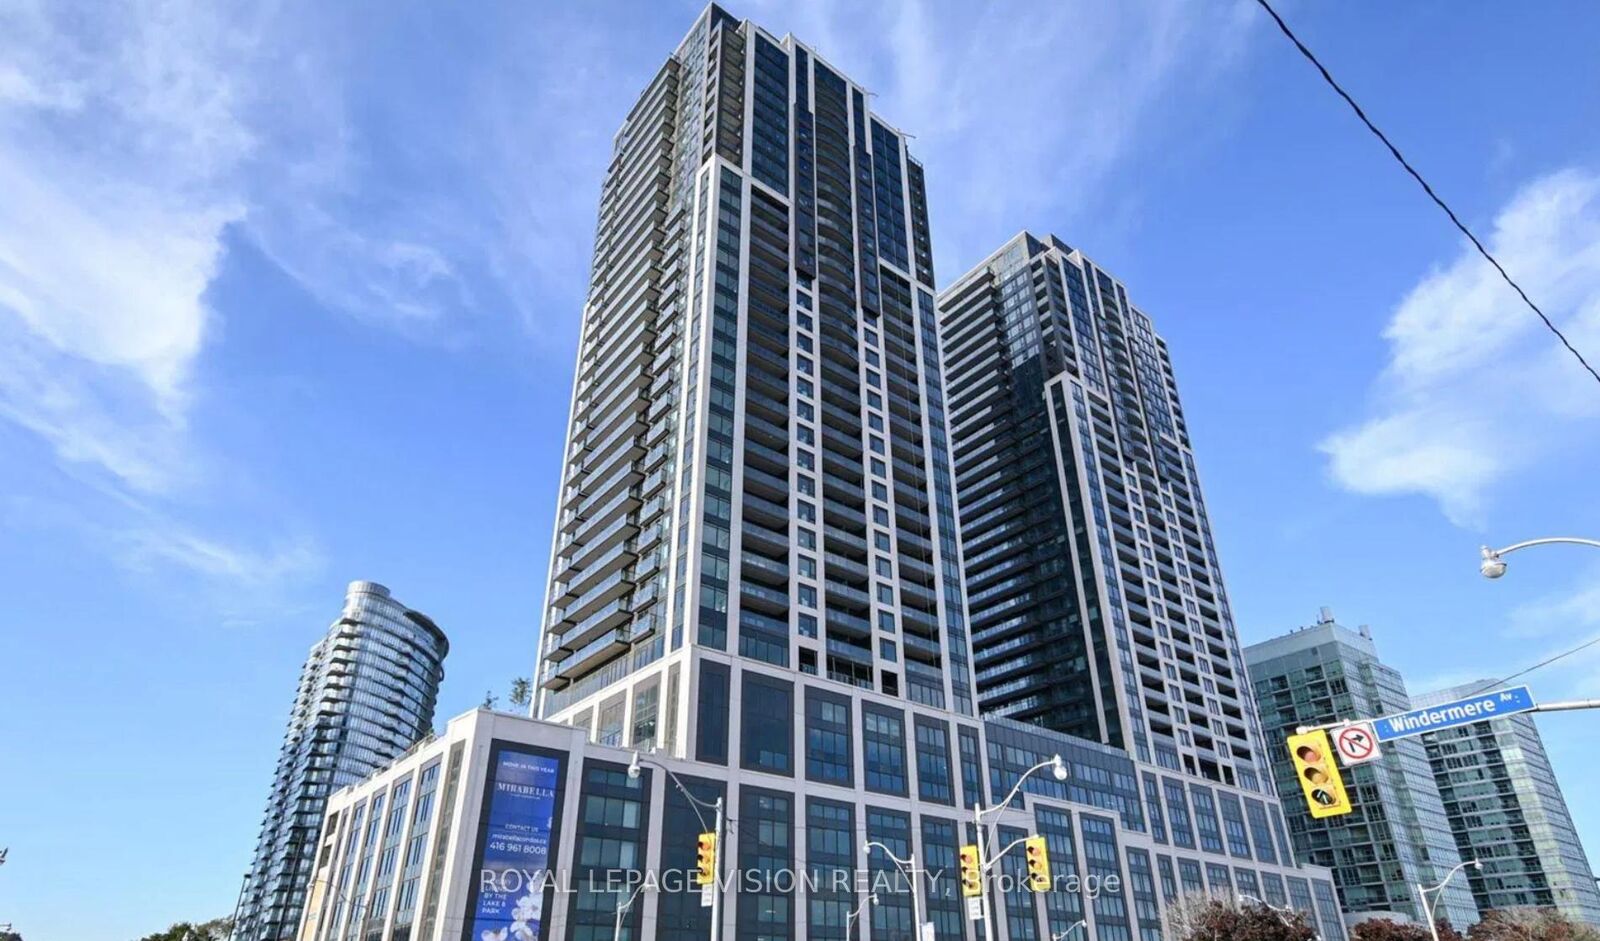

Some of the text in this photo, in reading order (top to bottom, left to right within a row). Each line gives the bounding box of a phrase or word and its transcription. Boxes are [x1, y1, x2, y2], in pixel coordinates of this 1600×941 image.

[1388, 692, 1513, 733] Windermere Av
[498, 782, 554, 798] MIRABELLA
[490, 841, 547, 855] 416 961 8008
